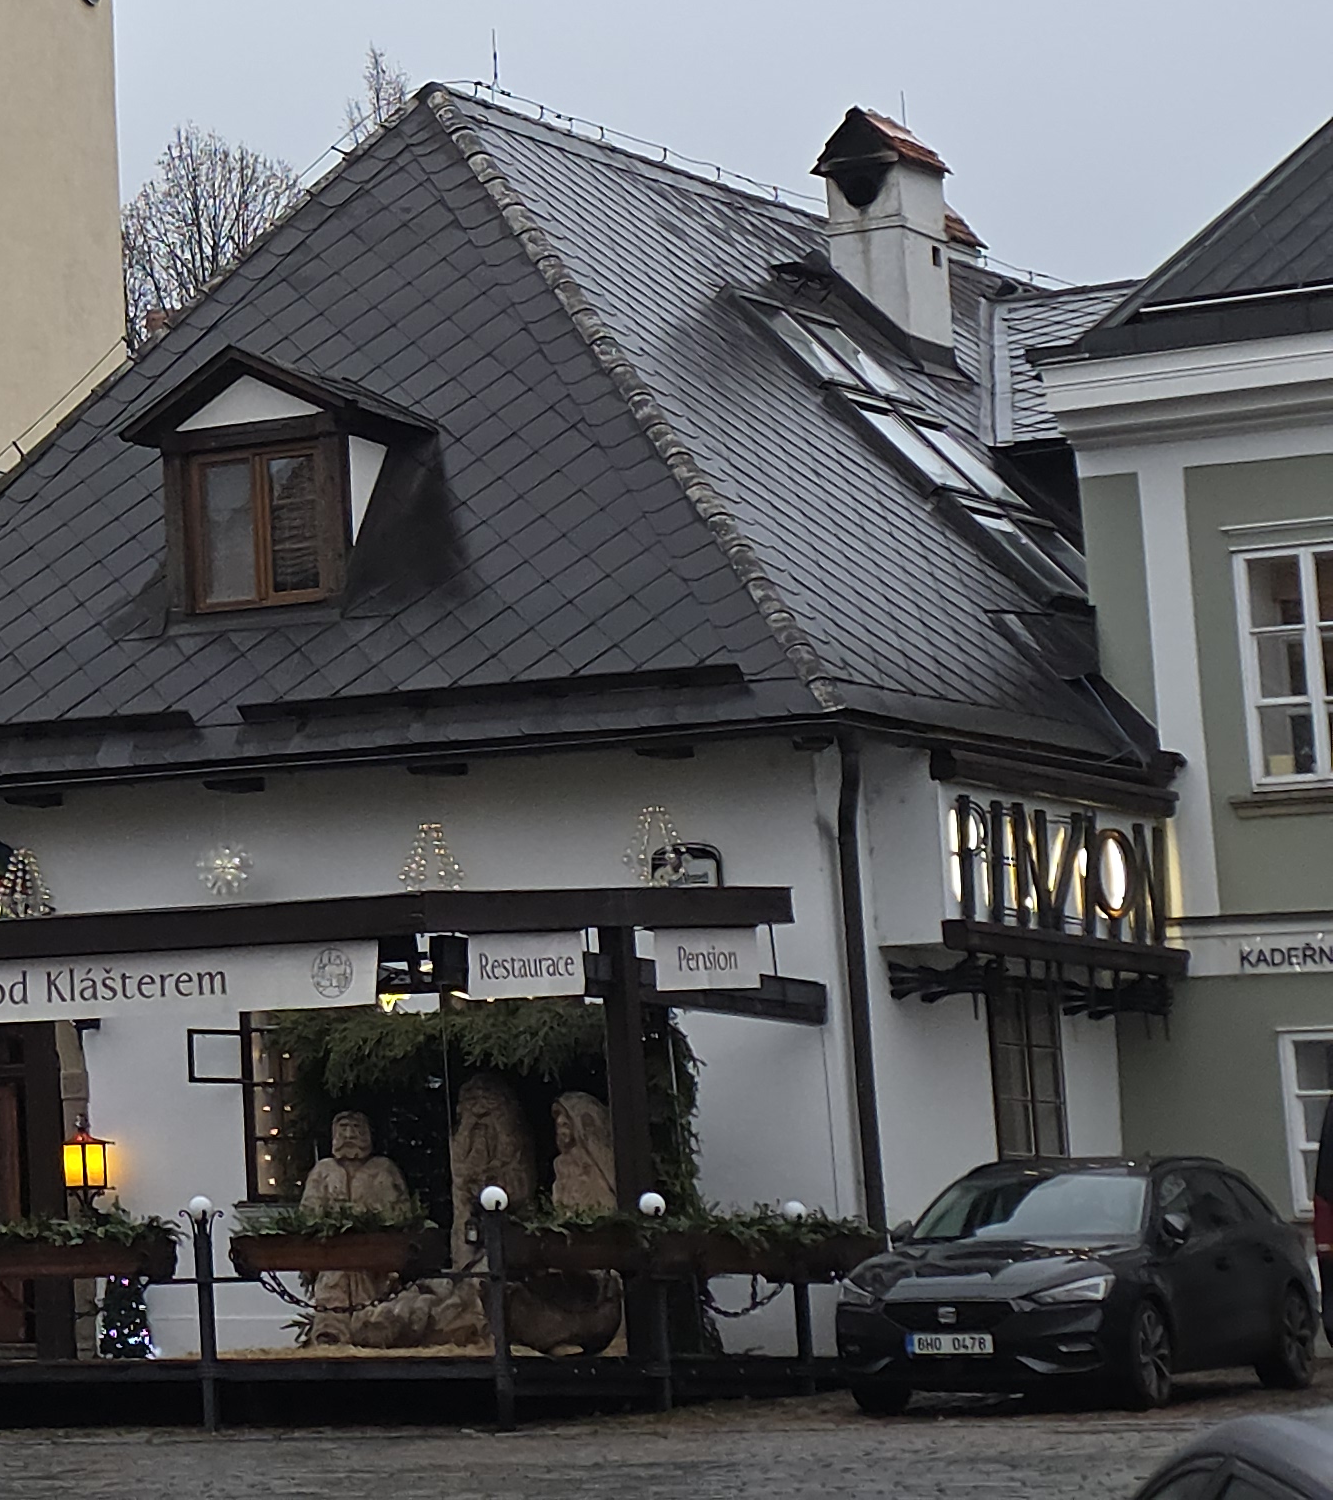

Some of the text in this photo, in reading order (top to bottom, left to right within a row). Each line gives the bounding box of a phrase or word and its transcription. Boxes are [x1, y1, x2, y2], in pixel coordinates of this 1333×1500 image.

[479, 952, 575, 980] Restaurace
[678, 945, 738, 972] Pension
[46, 966, 229, 1003] Klášterem
